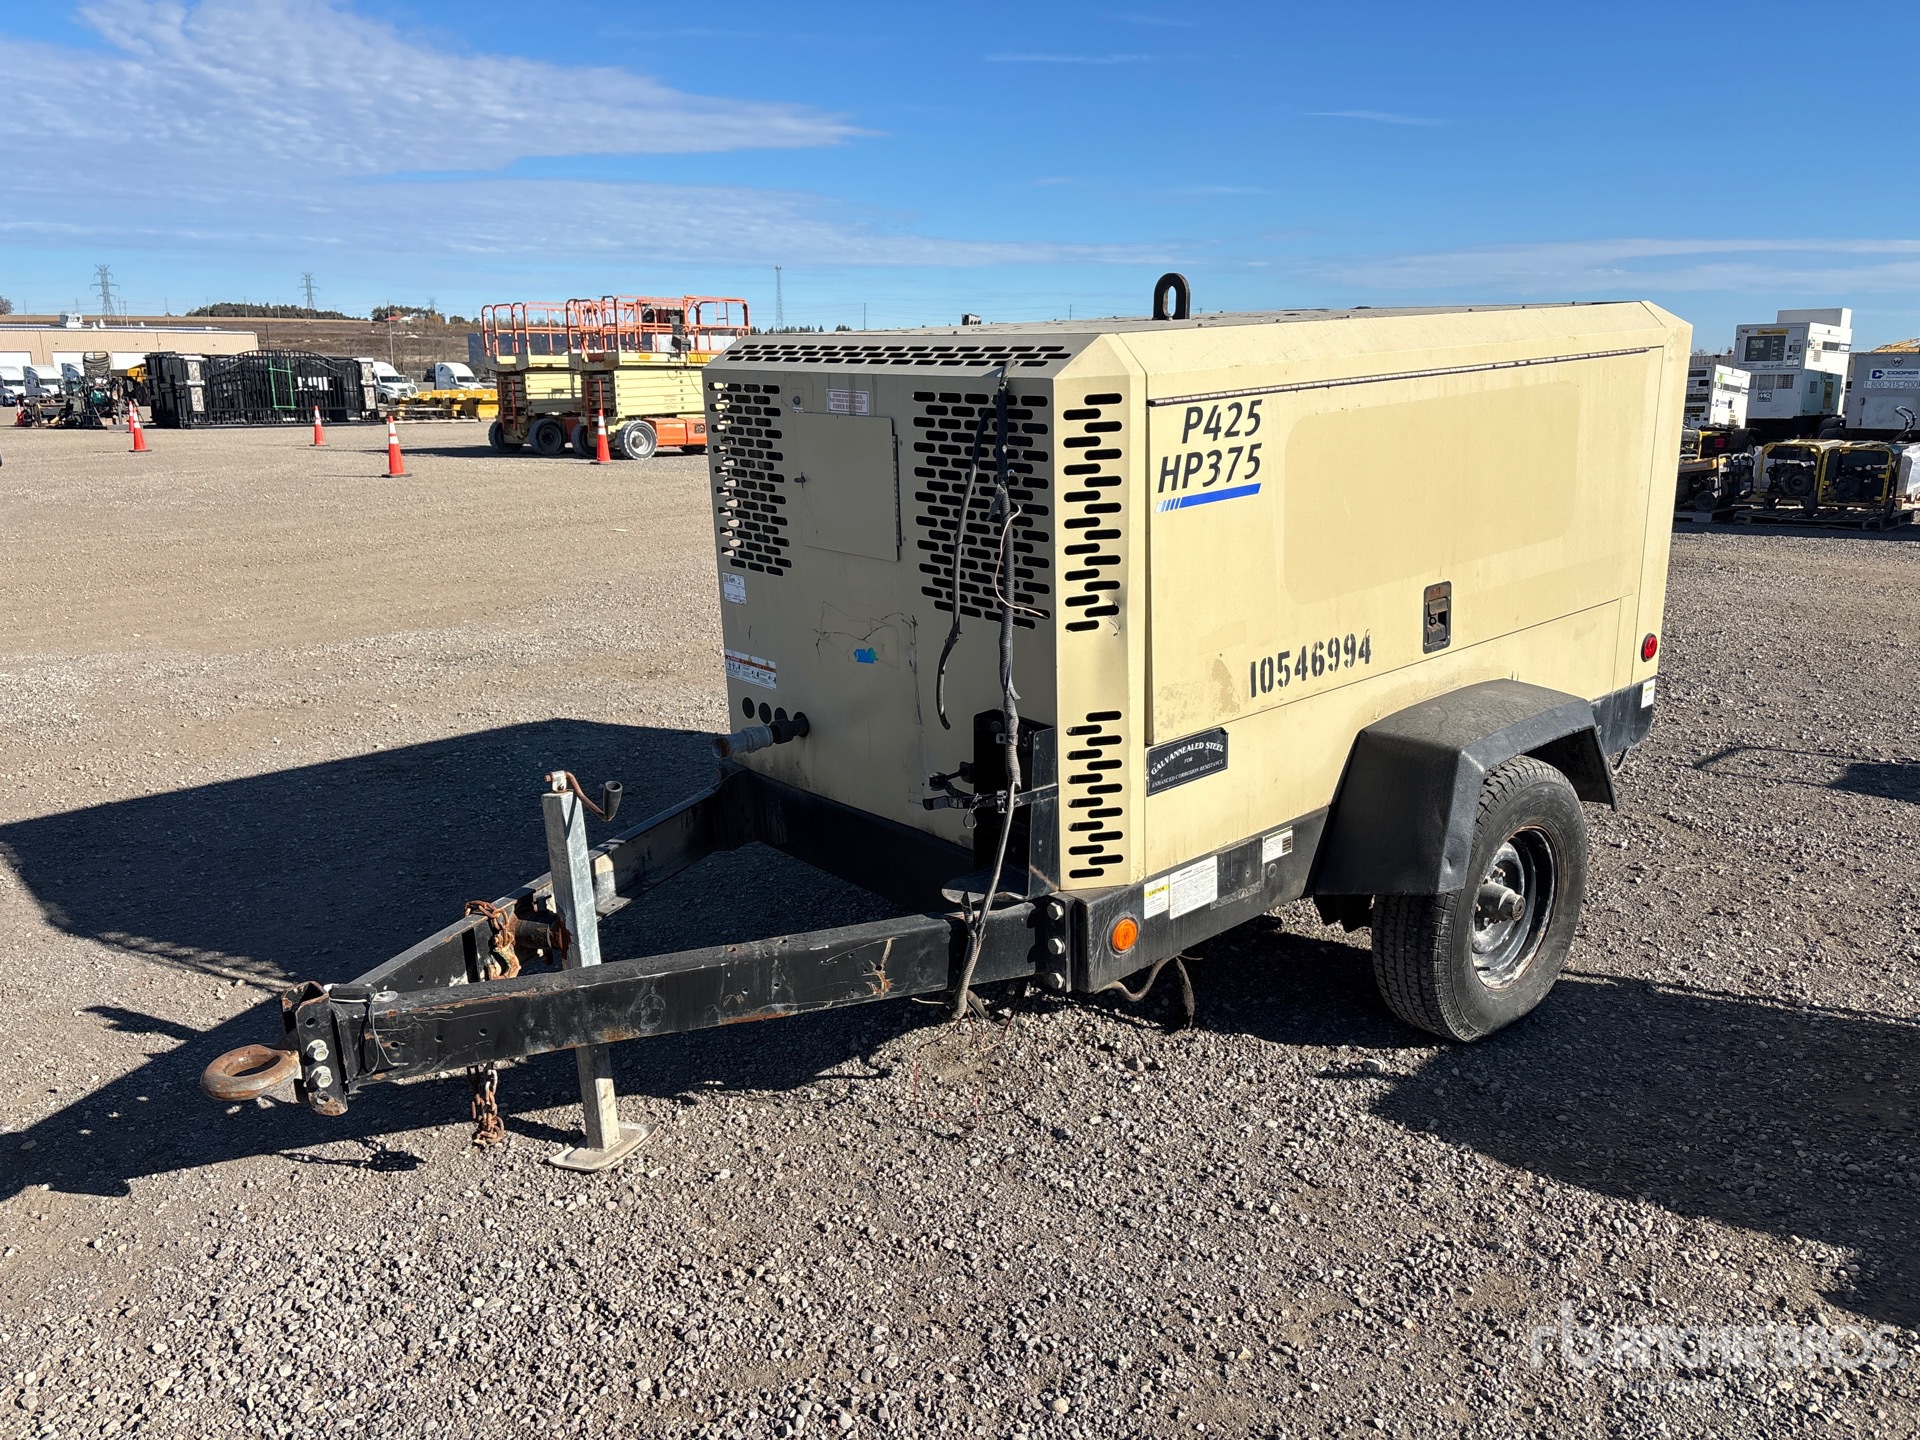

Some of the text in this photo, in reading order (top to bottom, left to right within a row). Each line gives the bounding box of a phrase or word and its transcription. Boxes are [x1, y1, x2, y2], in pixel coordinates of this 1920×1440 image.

[1181, 399, 1263, 444] P425
[1158, 442, 1263, 494] HP375
[1250, 628, 1372, 698] 10546994
[1151, 741, 1224, 775] GALVANNEALED STEEL
